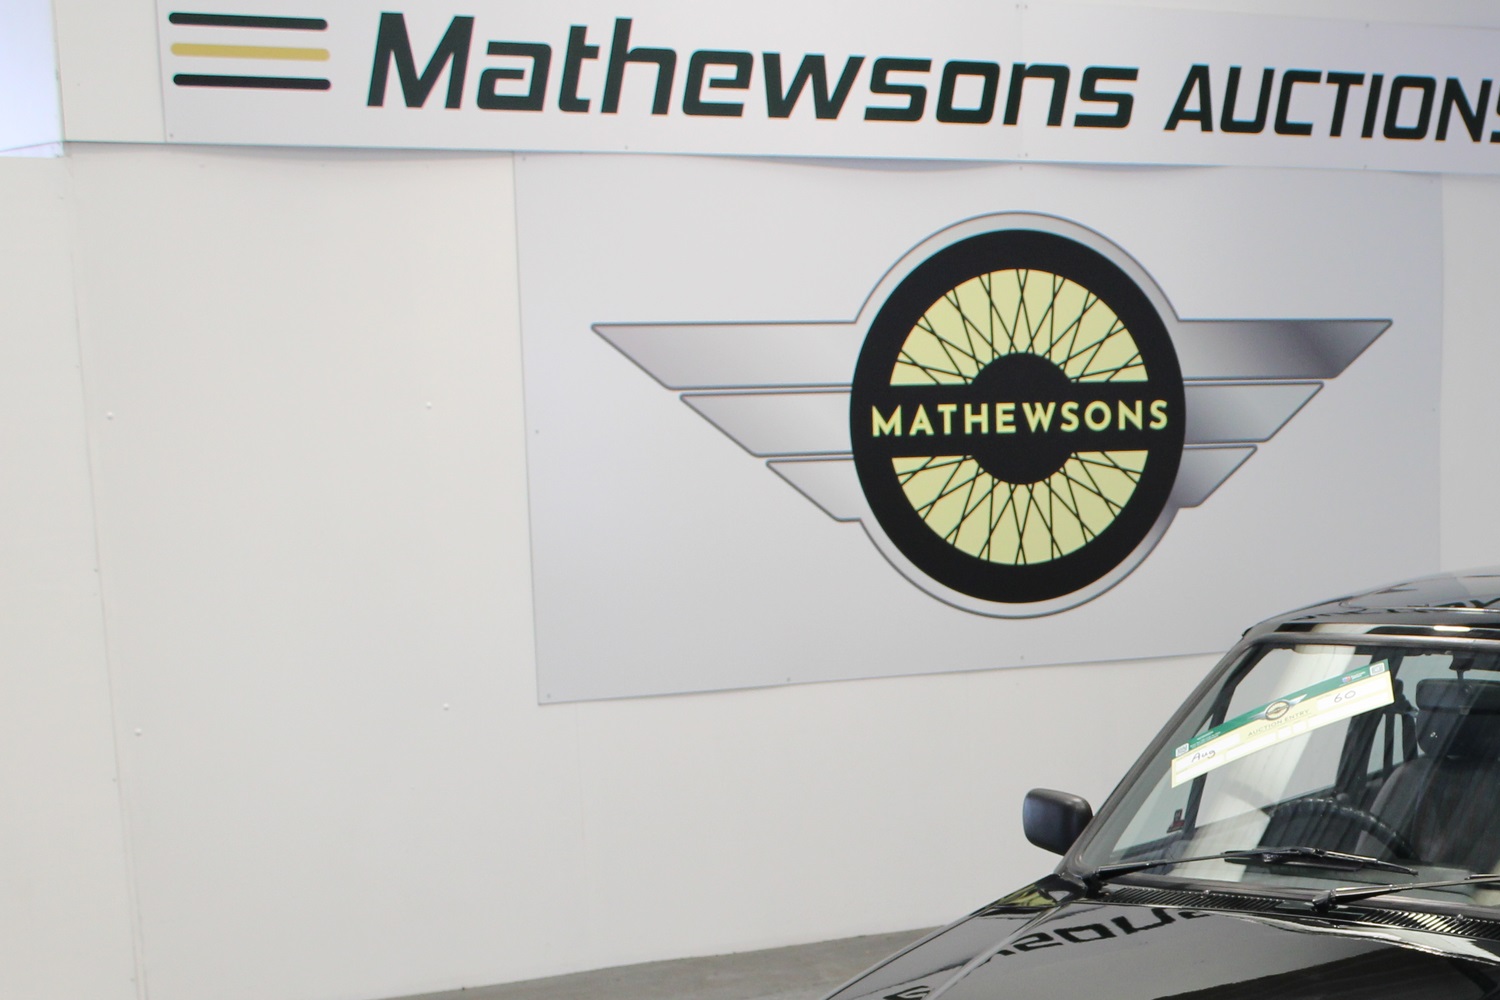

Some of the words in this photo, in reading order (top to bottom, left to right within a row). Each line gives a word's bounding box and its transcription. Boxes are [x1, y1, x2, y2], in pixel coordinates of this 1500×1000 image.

[366, 11, 1139, 129] Mathewsons
[871, 400, 1168, 437] MATHEWSONS
[1334, 690, 1356, 703] 60
[1248, 719, 1283, 736] AUCTION
[1284, 709, 1310, 721] ENTRY
